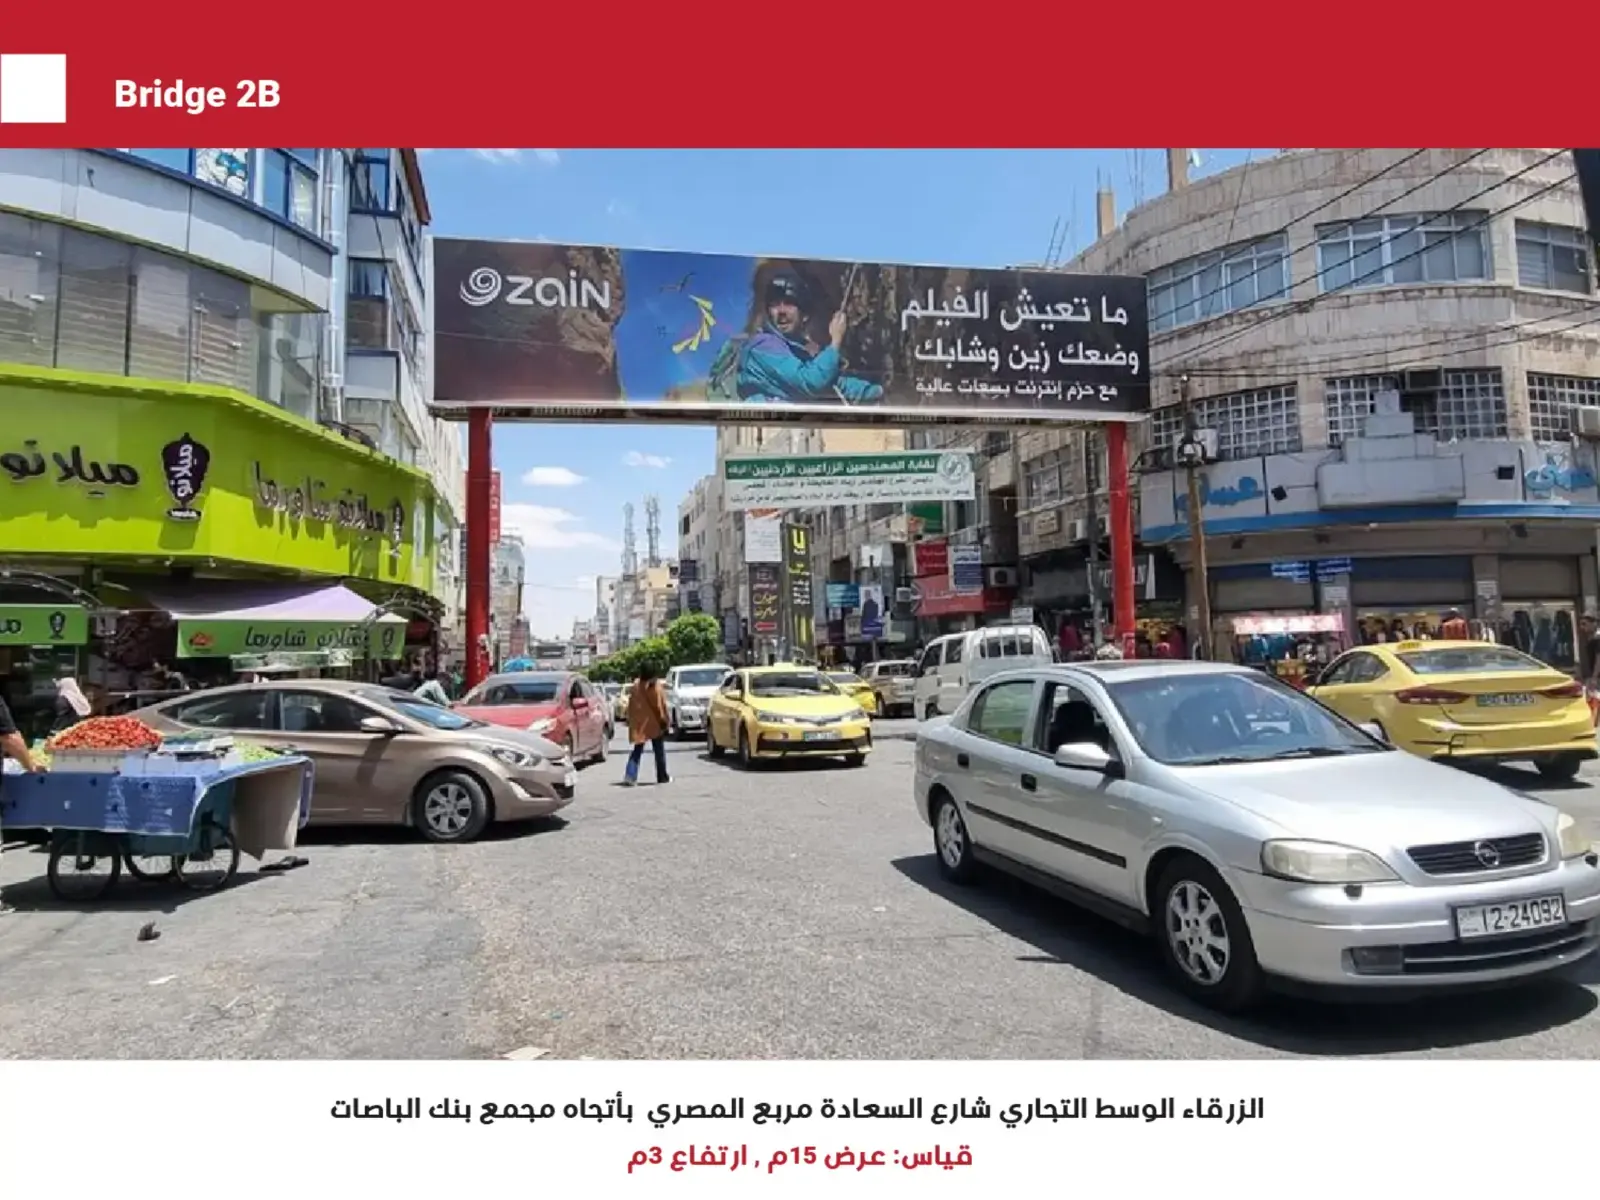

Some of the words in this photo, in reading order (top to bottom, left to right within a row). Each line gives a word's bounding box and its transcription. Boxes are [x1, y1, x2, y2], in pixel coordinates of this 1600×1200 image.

[901, 286, 989, 331] الفيلم
[1000, 288, 1092, 330] تعيش
[1101, 295, 1128, 325] ما
[914, 336, 1000, 372] وشابك
[1008, 342, 1051, 373] زين
[1058, 342, 1140, 374] وضعك
[915, 375, 953, 397] عالية
[957, 378, 1011, 399] بسعات
[1014, 379, 1063, 401] إنترنت
[1067, 381, 1095, 401] حزم
[1098, 385, 1118, 401] مع
[798, 460, 844, 477] الزراعيين
[846, 459, 905, 475] المهندسين
[907, 457, 935, 471] نقابة
